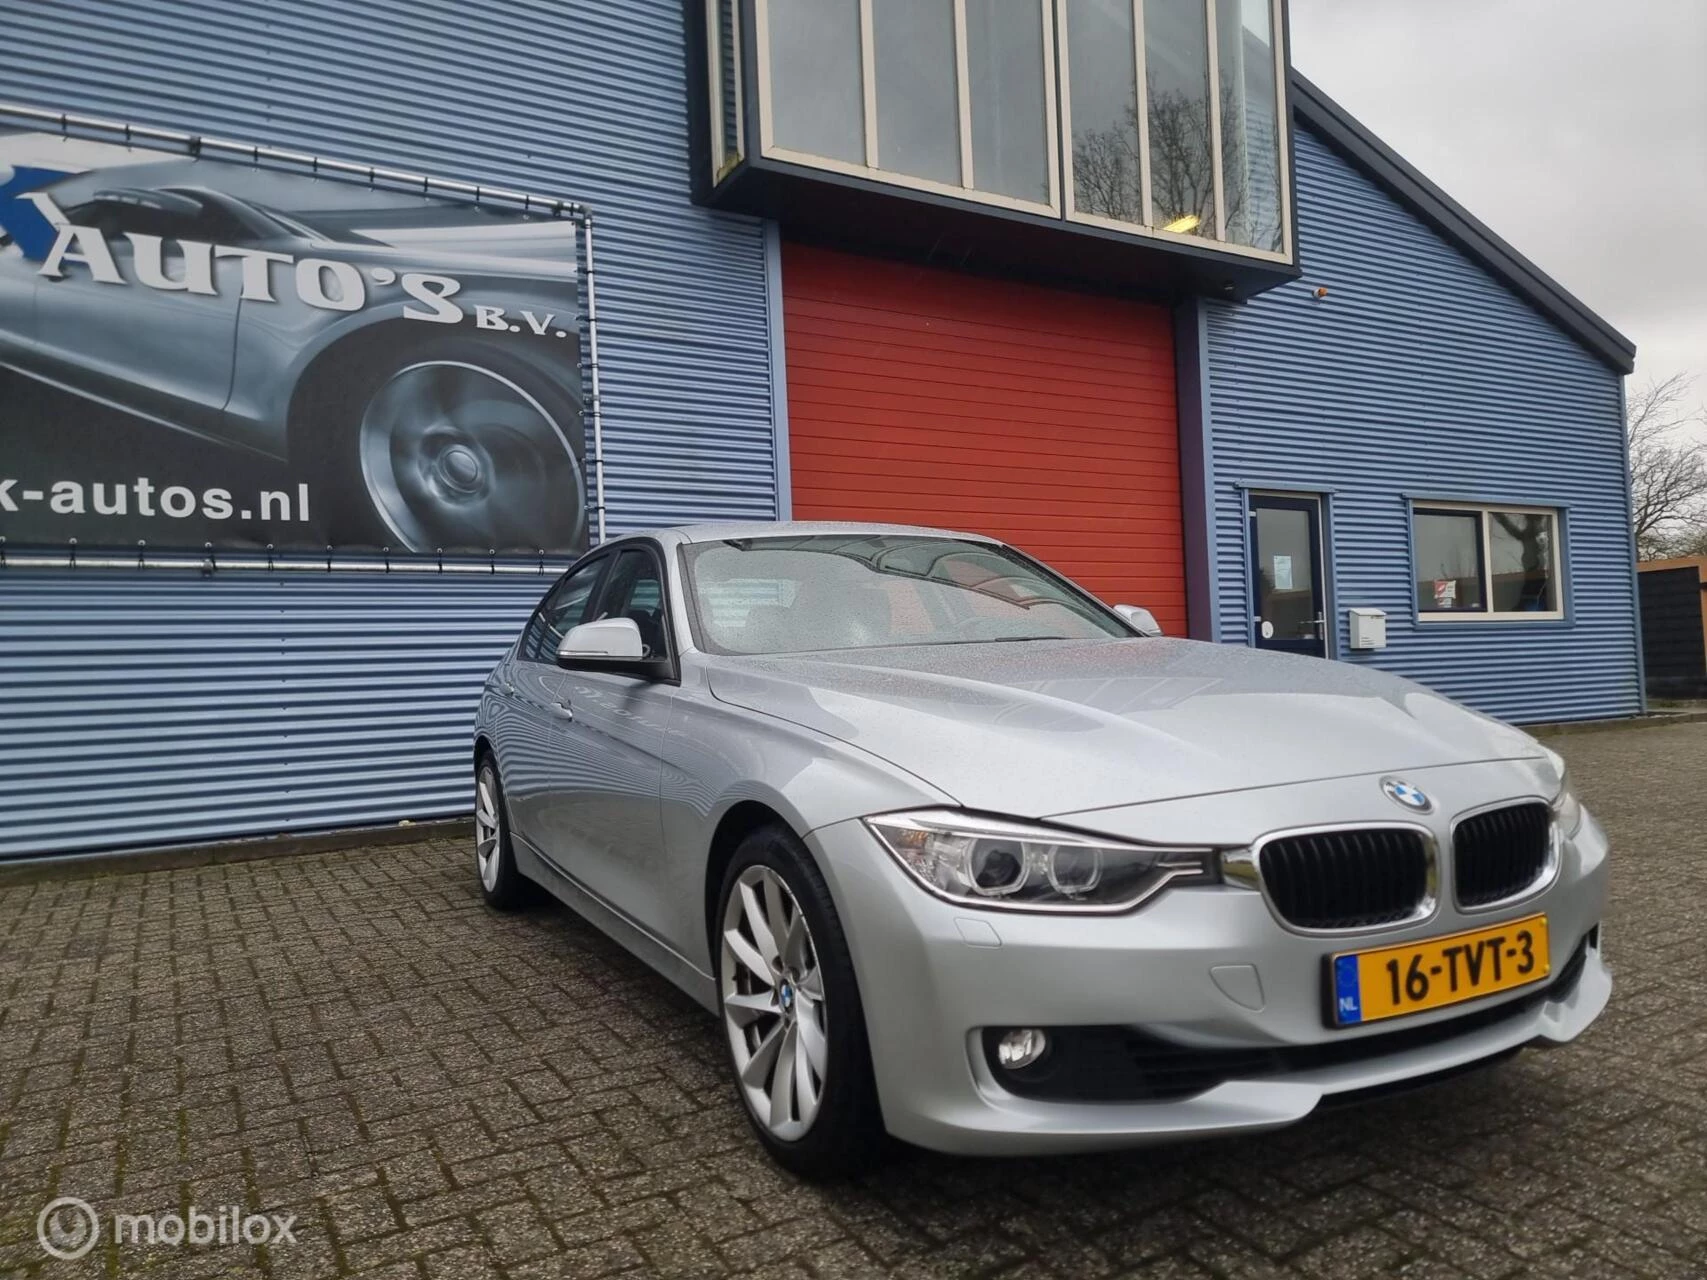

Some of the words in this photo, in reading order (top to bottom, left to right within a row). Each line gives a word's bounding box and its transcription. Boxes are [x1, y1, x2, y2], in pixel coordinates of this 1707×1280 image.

[15, 192, 464, 324] AUTO'S
[474, 305, 567, 338] B.V.
[1338, 996, 1358, 1013] NL
[1386, 930, 1535, 1006] 16-TVT-3
